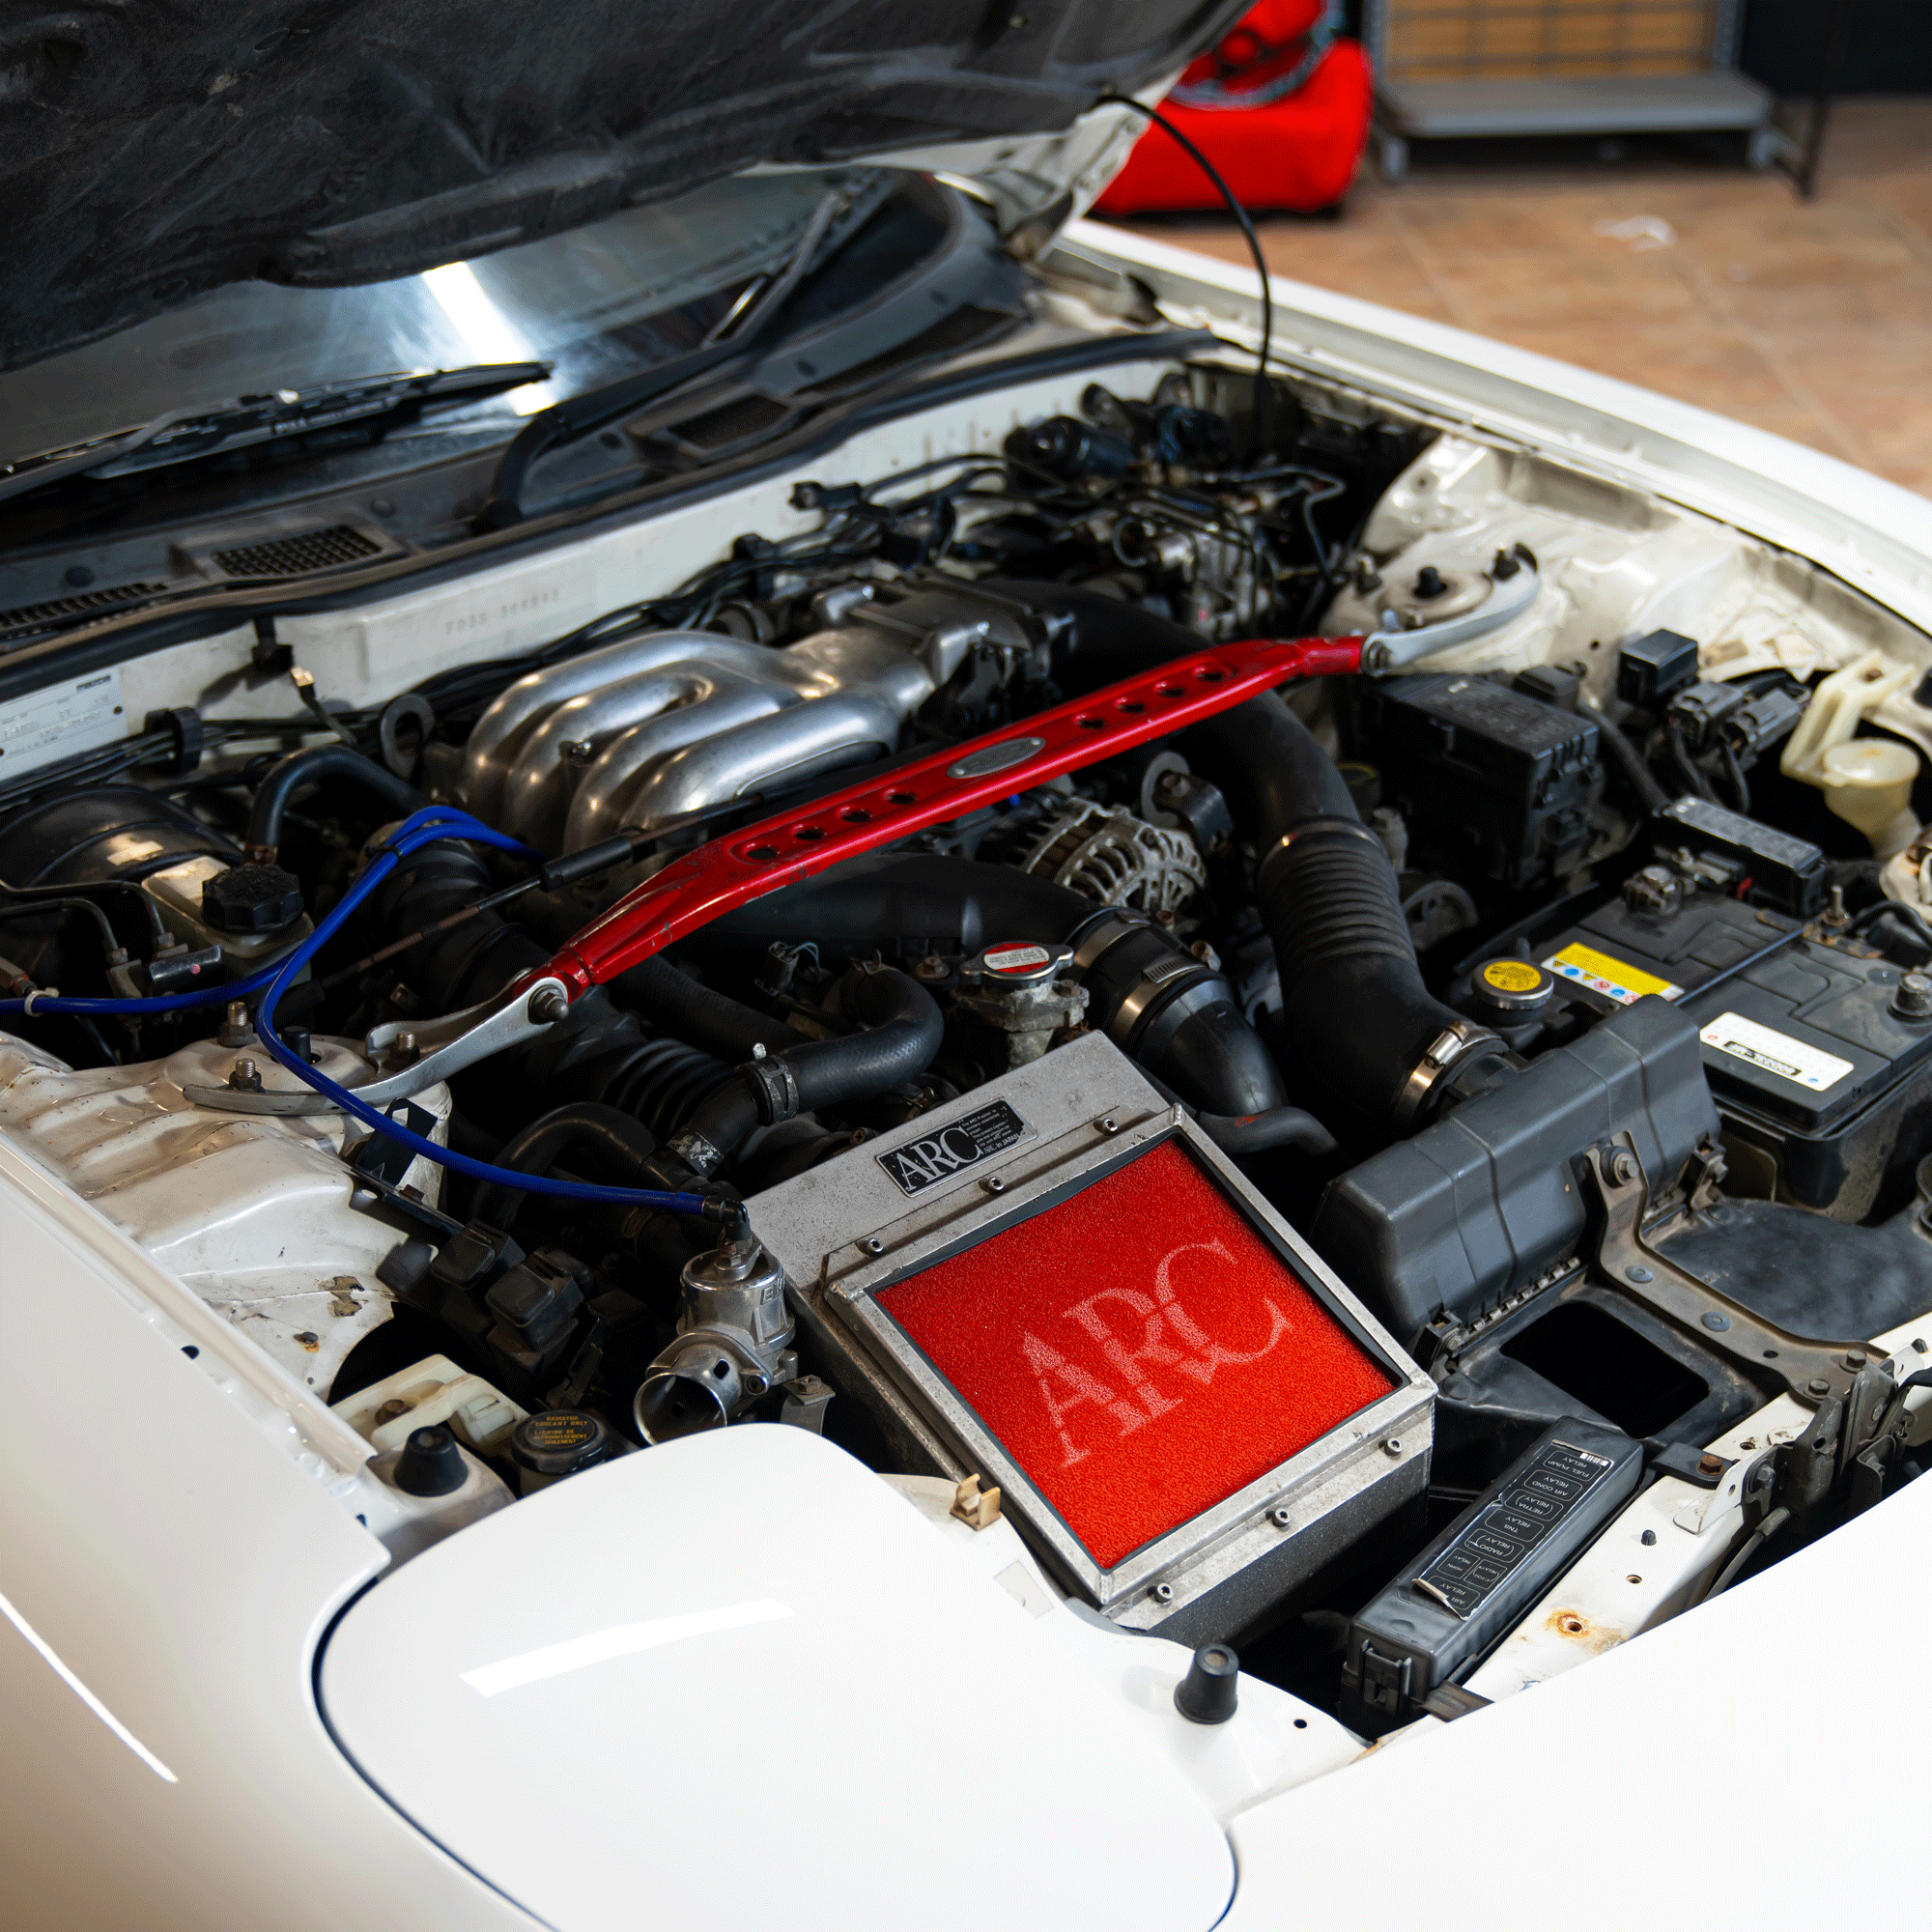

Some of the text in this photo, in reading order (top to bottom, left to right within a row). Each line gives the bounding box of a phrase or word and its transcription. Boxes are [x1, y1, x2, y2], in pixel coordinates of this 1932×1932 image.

[895, 1125, 984, 1192] ARC
[1022, 1237, 1294, 1467] ARC
[1562, 1457, 1587, 1468] RELAY
[1548, 1460, 1590, 1478] FUEL PUMP
[1531, 1480, 1554, 1492] COND
[1544, 1476, 1570, 1489] RELAY
[1503, 1523, 1519, 1533] TNS
[1505, 1516, 1531, 1528] RELAY
[1453, 1555, 1471, 1564] RELAY
[1439, 1583, 1466, 1596] RELAY
[1450, 1596, 1466, 1605] AIR
